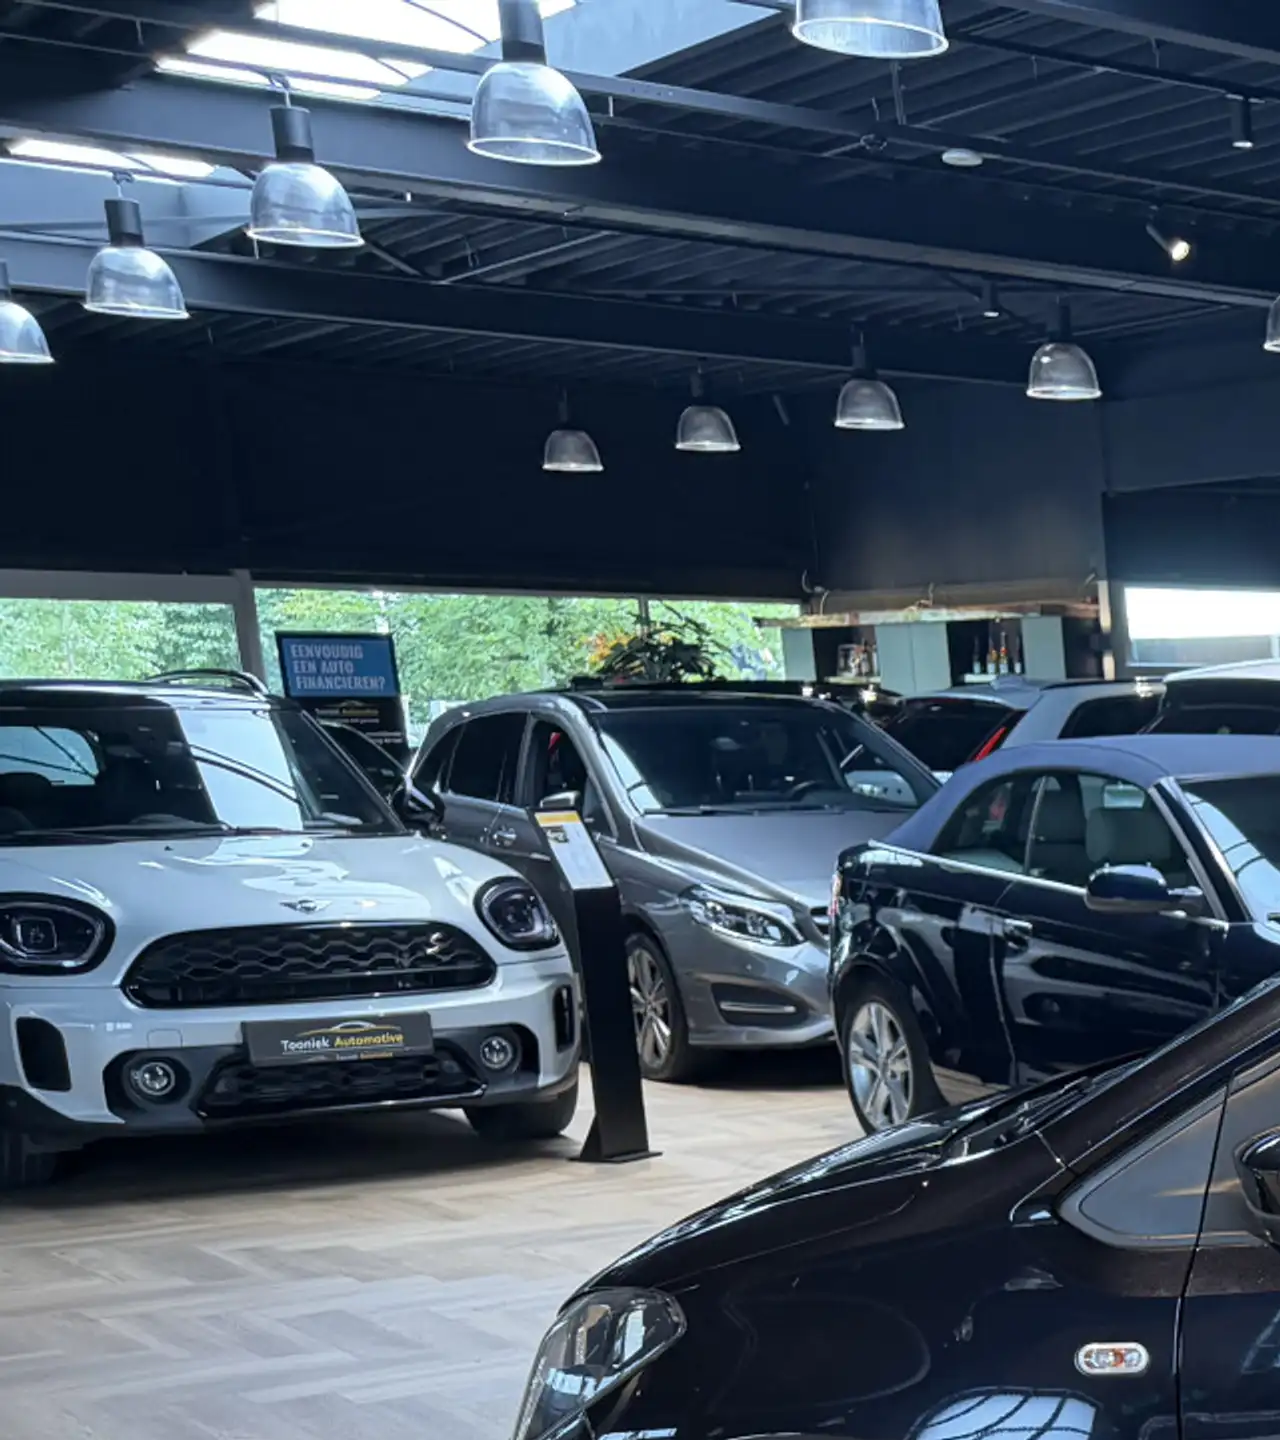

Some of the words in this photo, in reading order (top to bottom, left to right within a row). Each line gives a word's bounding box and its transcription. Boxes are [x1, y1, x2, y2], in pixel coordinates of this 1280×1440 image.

[290, 644, 364, 660] EENVOUDIG
[293, 660, 317, 674] EEN
[321, 660, 354, 674] AUTO
[296, 676, 386, 691] FINANCIEREN?
[280, 1035, 331, 1053] Tooniek
[334, 1031, 404, 1048] Automotive
